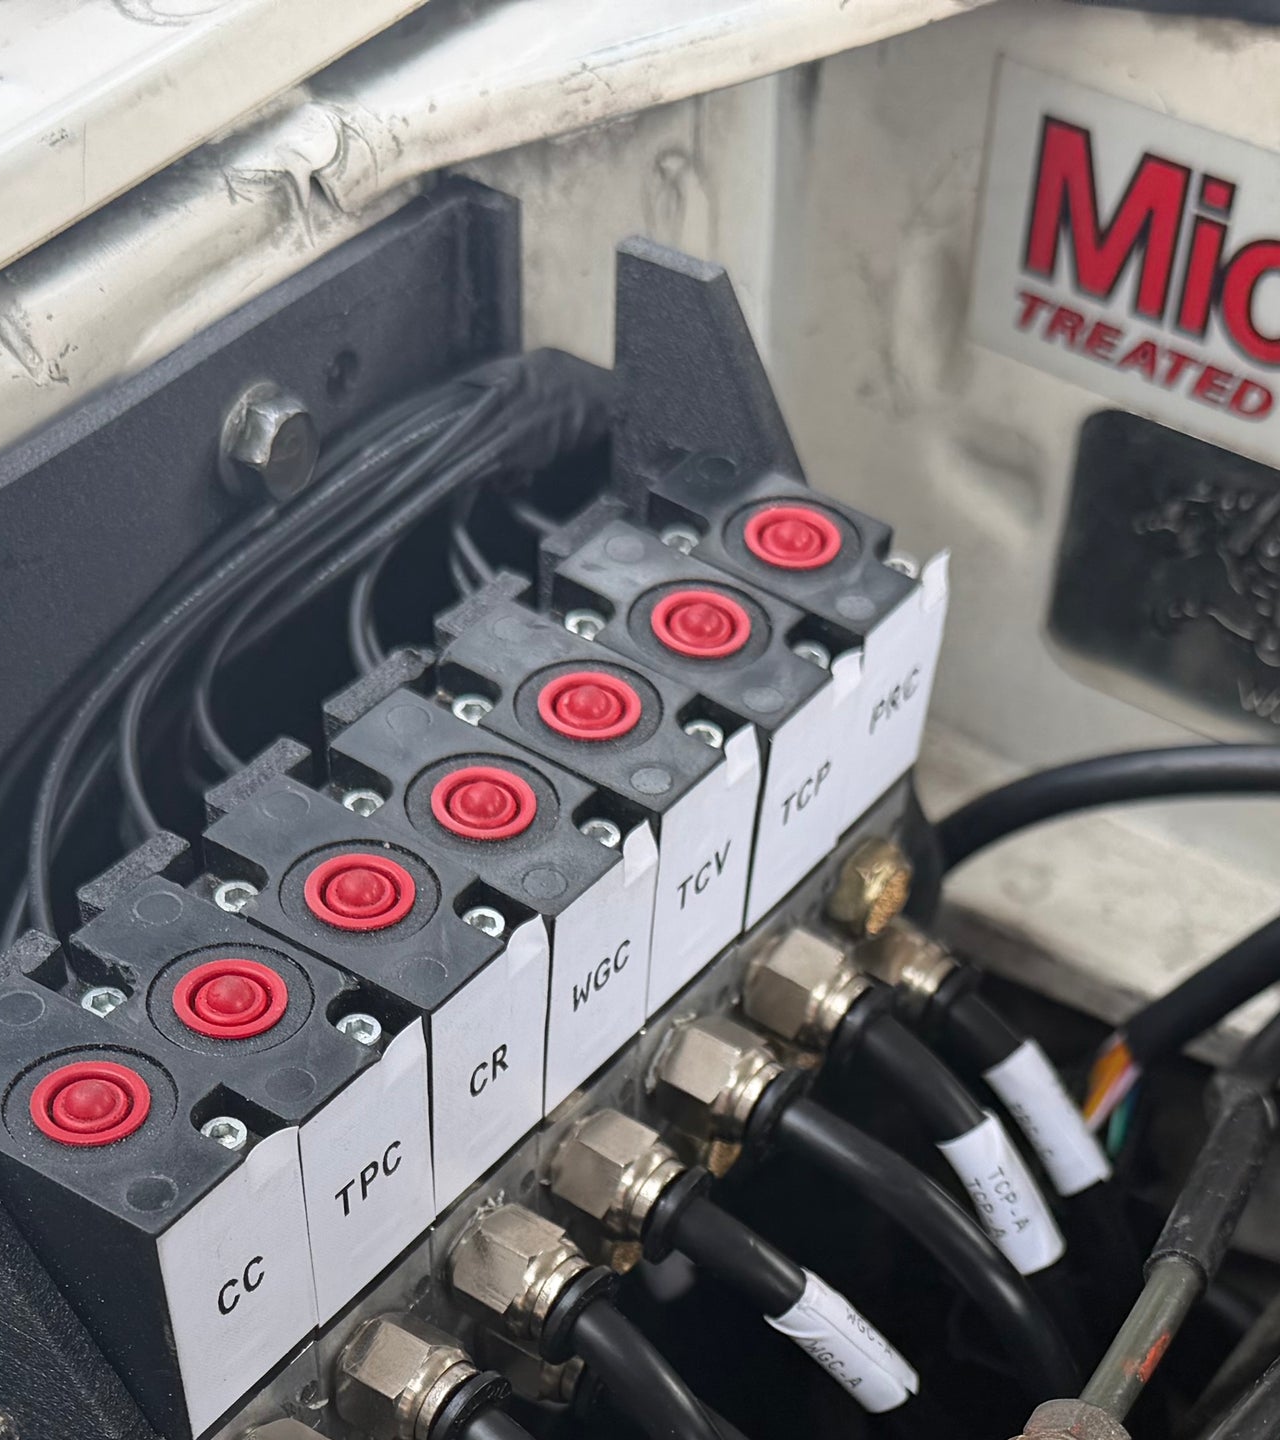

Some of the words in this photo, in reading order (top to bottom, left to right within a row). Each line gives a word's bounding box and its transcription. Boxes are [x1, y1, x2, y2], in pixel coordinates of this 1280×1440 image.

[1016, 290, 1275, 419] TREATED
[780, 760, 832, 826] TCP
[676, 839, 732, 910] TCV
[571, 938, 631, 1013] WGC
[468, 1043, 510, 1098] CR
[334, 1139, 403, 1217] TPC
[987, 1165, 1030, 1233] TCP-A
[216, 1254, 266, 1316] CC
[803, 1339, 864, 1389] WGC-A
